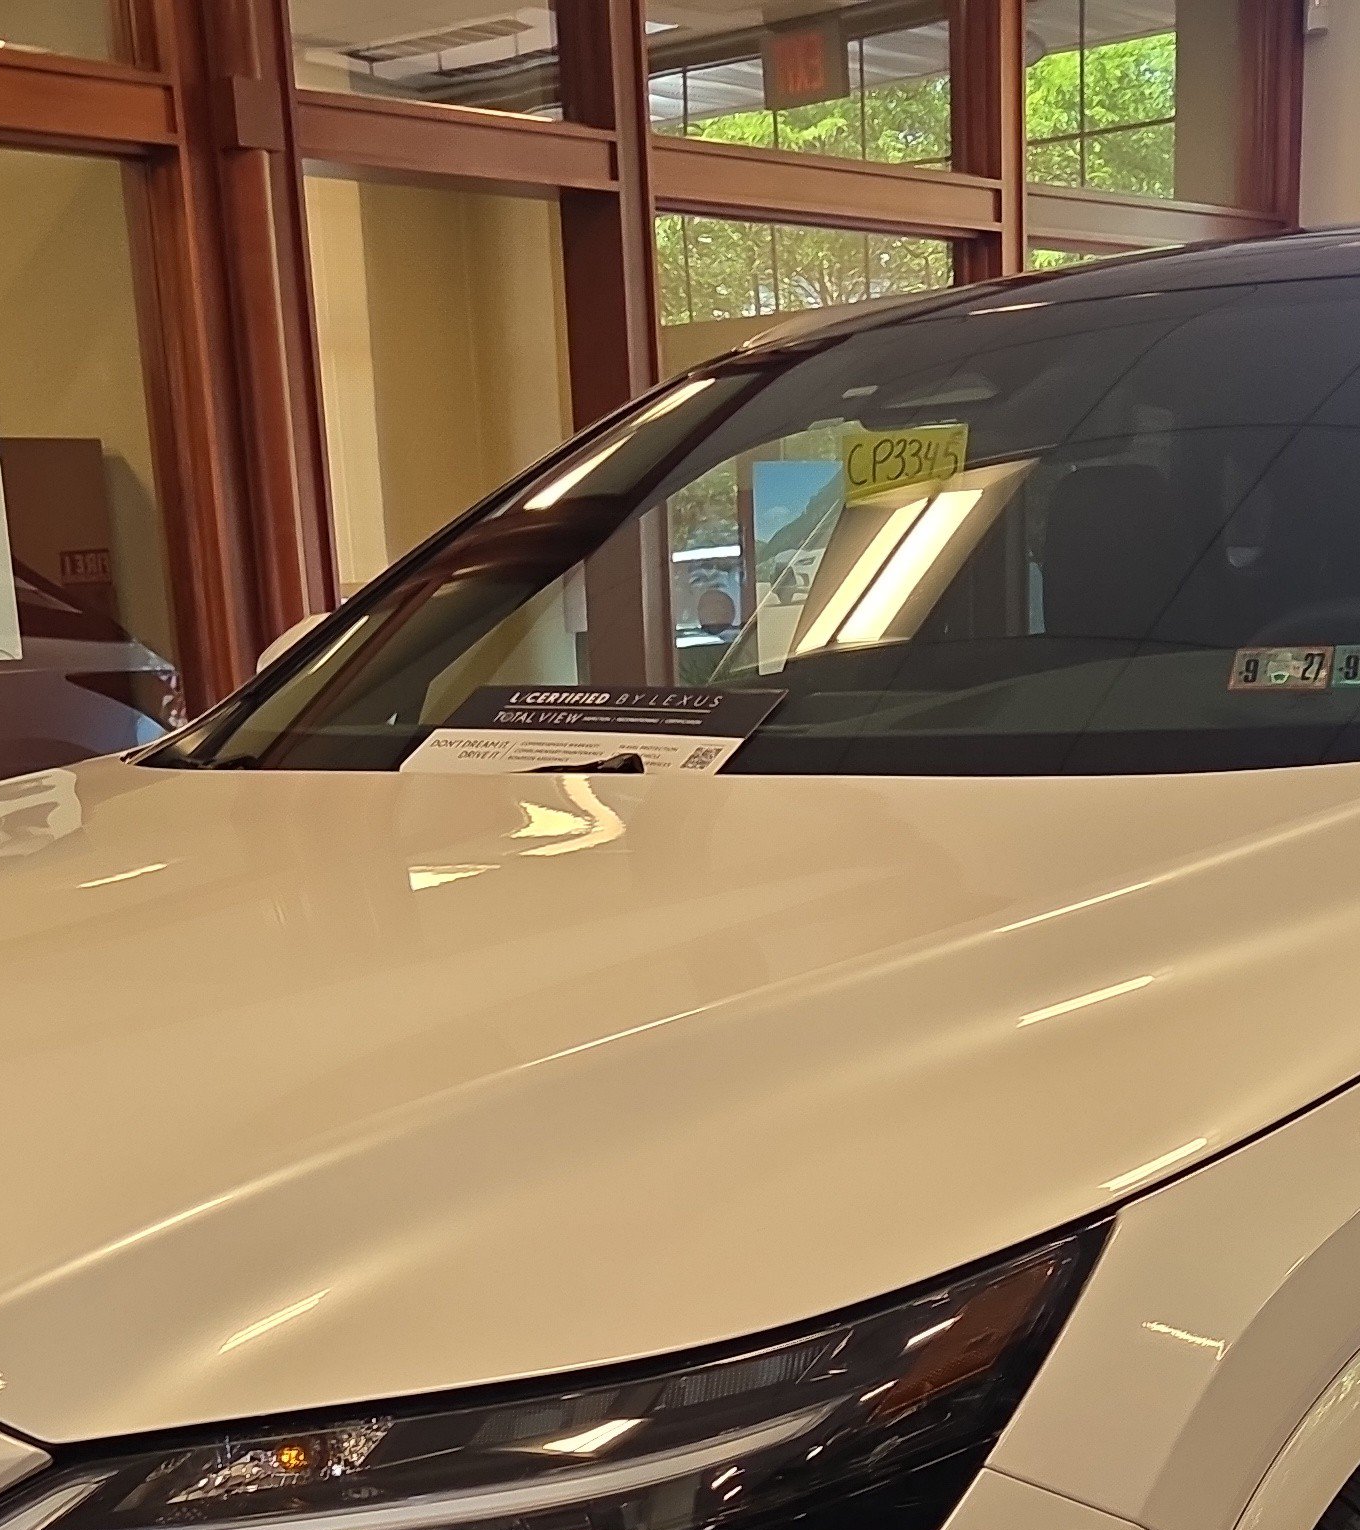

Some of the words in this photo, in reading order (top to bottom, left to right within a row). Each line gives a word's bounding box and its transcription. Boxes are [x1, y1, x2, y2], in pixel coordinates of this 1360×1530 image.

[846, 438, 960, 486] CP3345
[1300, 652, 1326, 683] 27
[615, 694, 647, 706] BY
[649, 694, 724, 708] LEXUS
[492, 710, 534, 724] TOTAL
[538, 712, 585, 725] VIEW
